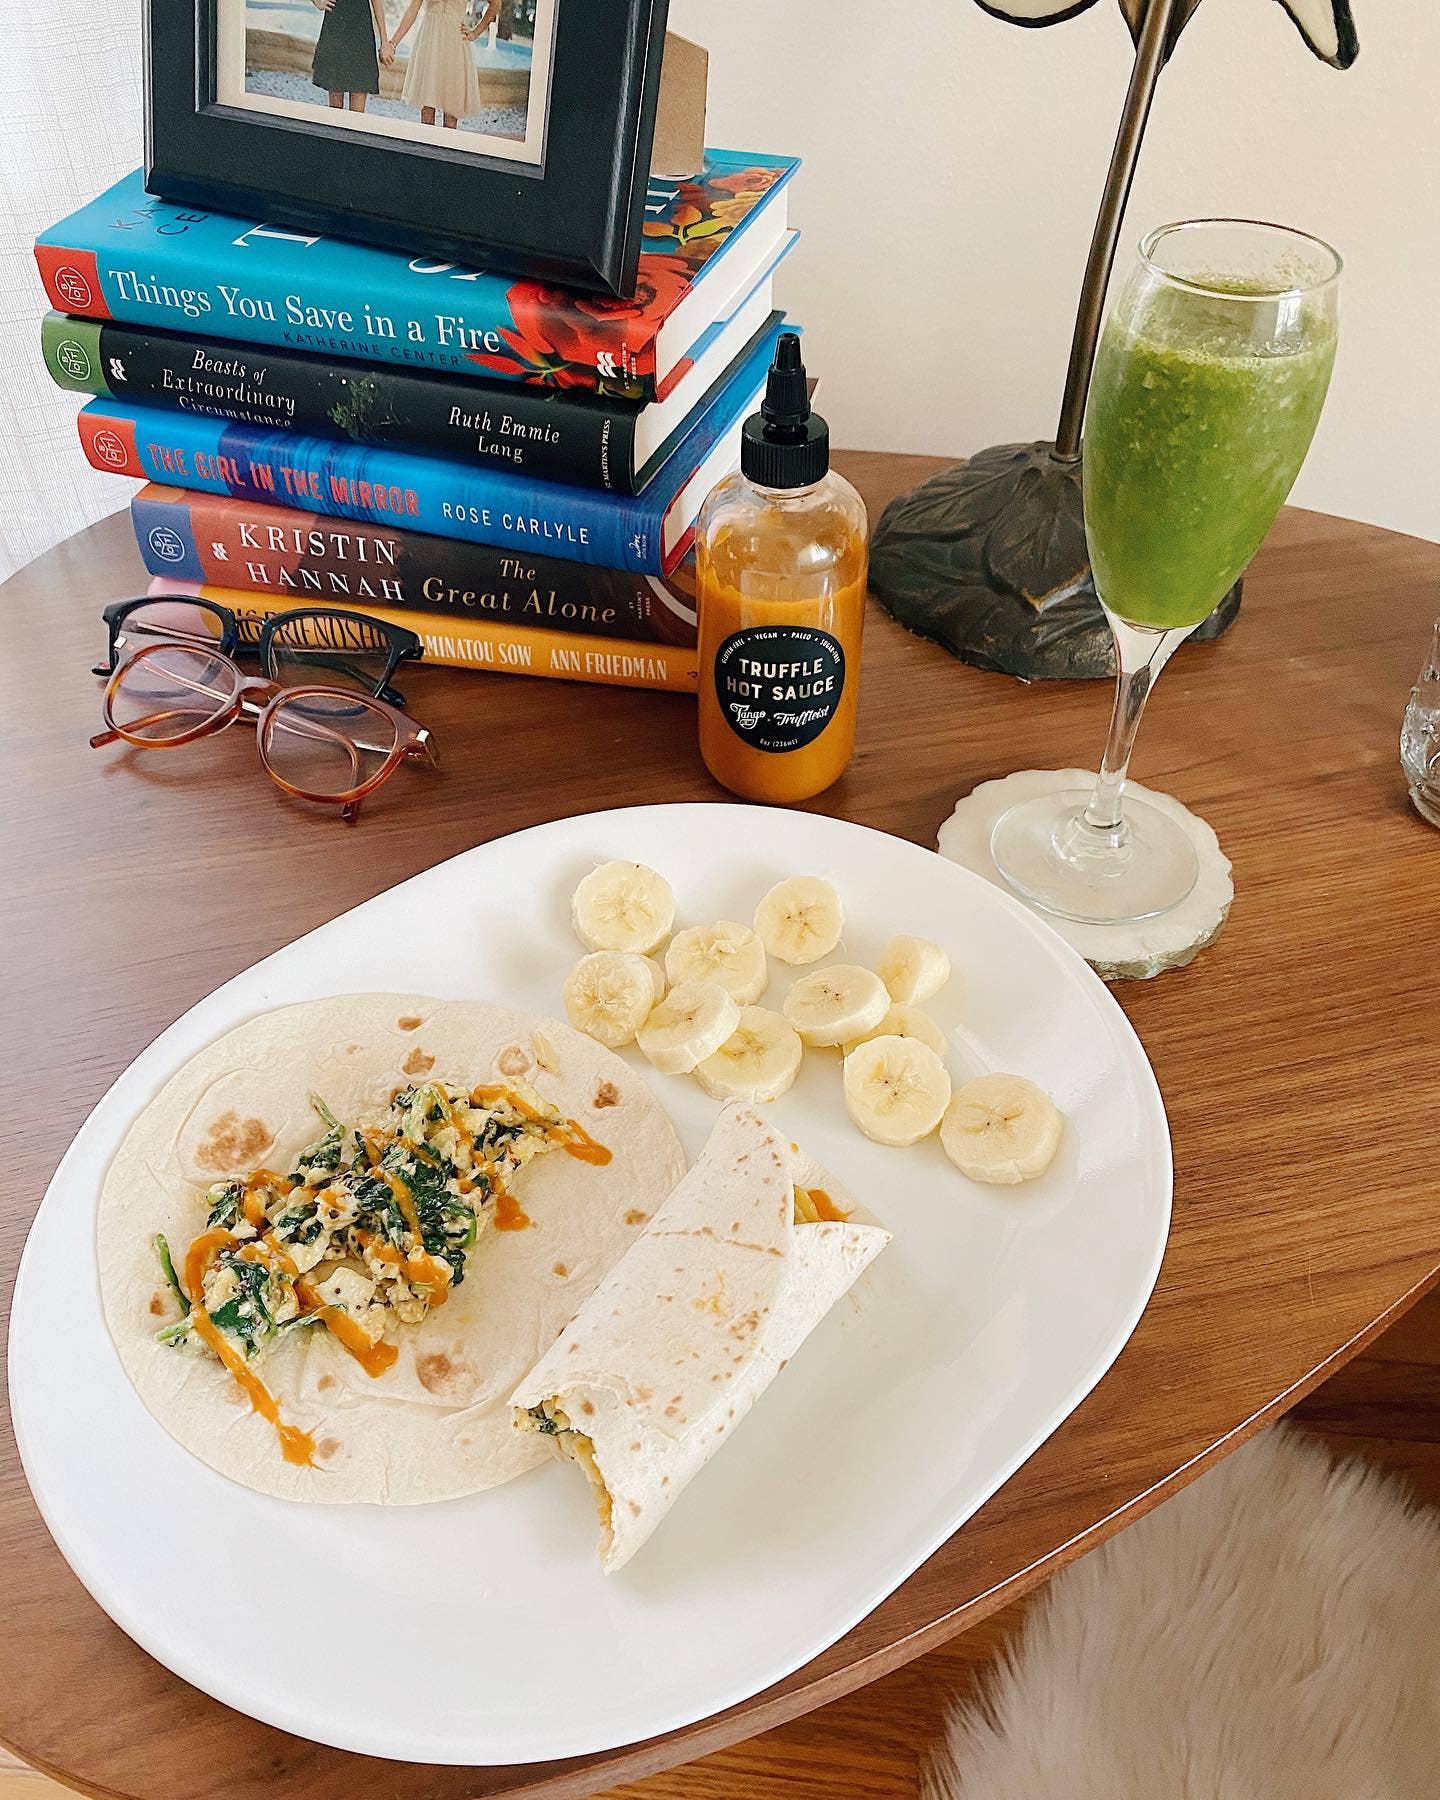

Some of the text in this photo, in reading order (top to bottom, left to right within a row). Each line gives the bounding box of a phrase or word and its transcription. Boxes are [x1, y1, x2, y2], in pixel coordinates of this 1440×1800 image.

[108, 270, 501, 353] Things You Save in a Fire
[283, 331, 460, 367] KATHERINE CENTER
[191, 349, 267, 386] Beasts of
[163, 368, 295, 416] Extraordinary
[179, 396, 292, 427] Circumstance
[448, 406, 560, 444] Ruth Emmie
[602, 419, 610, 445] PRESS
[478, 435, 523, 464] Lang
[147, 443, 421, 518] THE GIRL IN THE MIRROR
[442, 502, 589, 544] ROSE CARLYLE
[238, 522, 396, 566] KRISTIN
[246, 562, 405, 601] HANNAH
[500, 558, 536, 581] The
[423, 577, 616, 624] Great Alone
[754, 632, 778, 640] VEGAN
[791, 631, 812, 640] PALEO
[499, 643, 532, 667] SOW
[550, 648, 667, 681] ANN FRIEDMAN
[739, 657, 824, 679] TRUFFLE
[726, 675, 835, 701] HOT SAUCE
[730, 703, 766, 730] Tango
